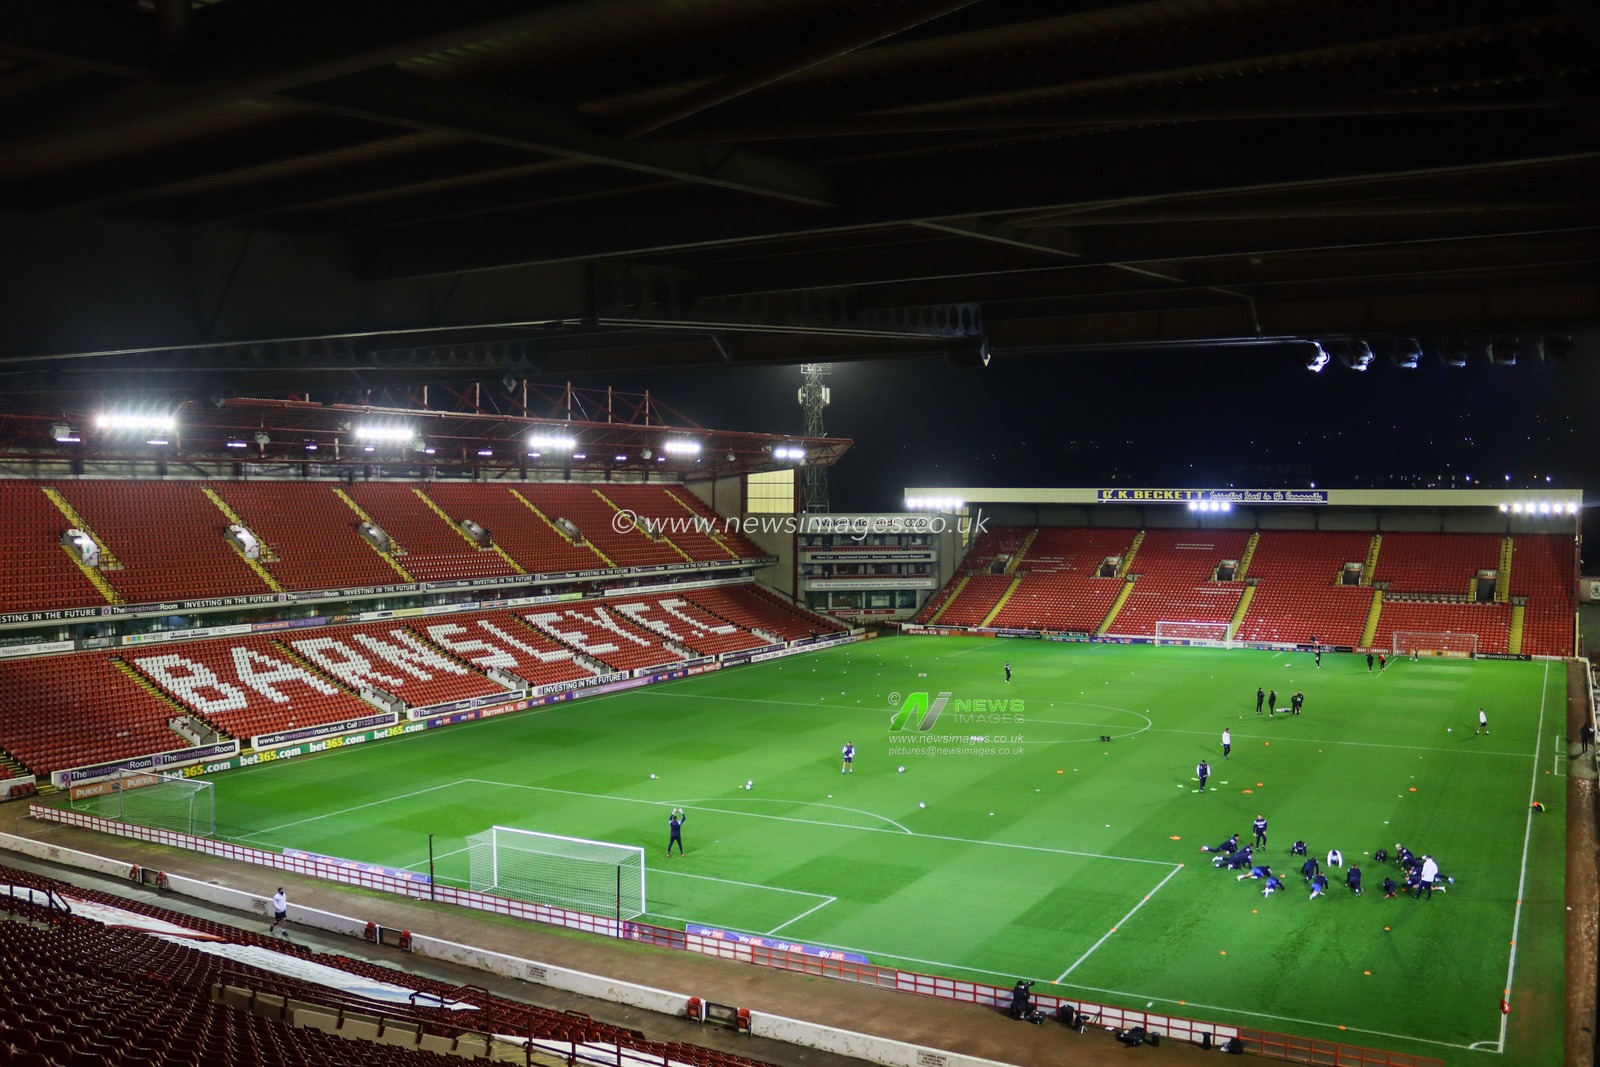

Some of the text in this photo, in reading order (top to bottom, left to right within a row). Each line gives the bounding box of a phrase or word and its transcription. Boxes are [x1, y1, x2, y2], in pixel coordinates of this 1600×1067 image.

[1209, 490, 1242, 501] Supporting
[1244, 490, 1262, 501] Sport
[1263, 491, 1272, 500] in
[1273, 491, 1284, 500] the
[1285, 491, 1323, 502] Community
[472, 577, 498, 586] INVESTING
[505, 576, 514, 584] THE
[515, 575, 533, 583] FUTURE
[343, 587, 375, 596] INVESTING
[384, 585, 395, 593] THE
[396, 584, 416, 592] FUTURE
[112, 603, 178, 614] TheInvestmentRoom
[184, 595, 274, 609] INVESTING IN THE FUTURE
[0, 609, 96, 624] STING IN THE FUTURE
[134, 605, 650, 714] BARNSLEY
[543, 682, 578, 695] INVESTING
[578, 680, 585, 689] IN
[585, 678, 598, 687] THE
[598, 674, 621, 685] FUTURE
[482, 706, 505, 717] Burrows
[505, 704, 514, 713] Kia
[435, 718, 443, 726] sky
[258, 715, 395, 745] www.theinvestmentroom.co.uk Call 01226 392 940
[373, 722, 424, 740] bet365.com
[309, 733, 366, 753] bet365.com
[163, 744, 235, 764] TheInvestmentRoom
[240, 746, 302, 767] bet365.com
[71, 758, 152, 780] TheInvestmentRoom
[163, 760, 231, 782] bet365.com
[127, 776, 154, 788] PUKKA
[76, 786, 103, 798] PUKKA
[700, 928, 724, 938] sky bet
[738, 935, 762, 945] sky bet
[778, 942, 802, 953] sky bet
[818, 949, 844, 960] sky bet
